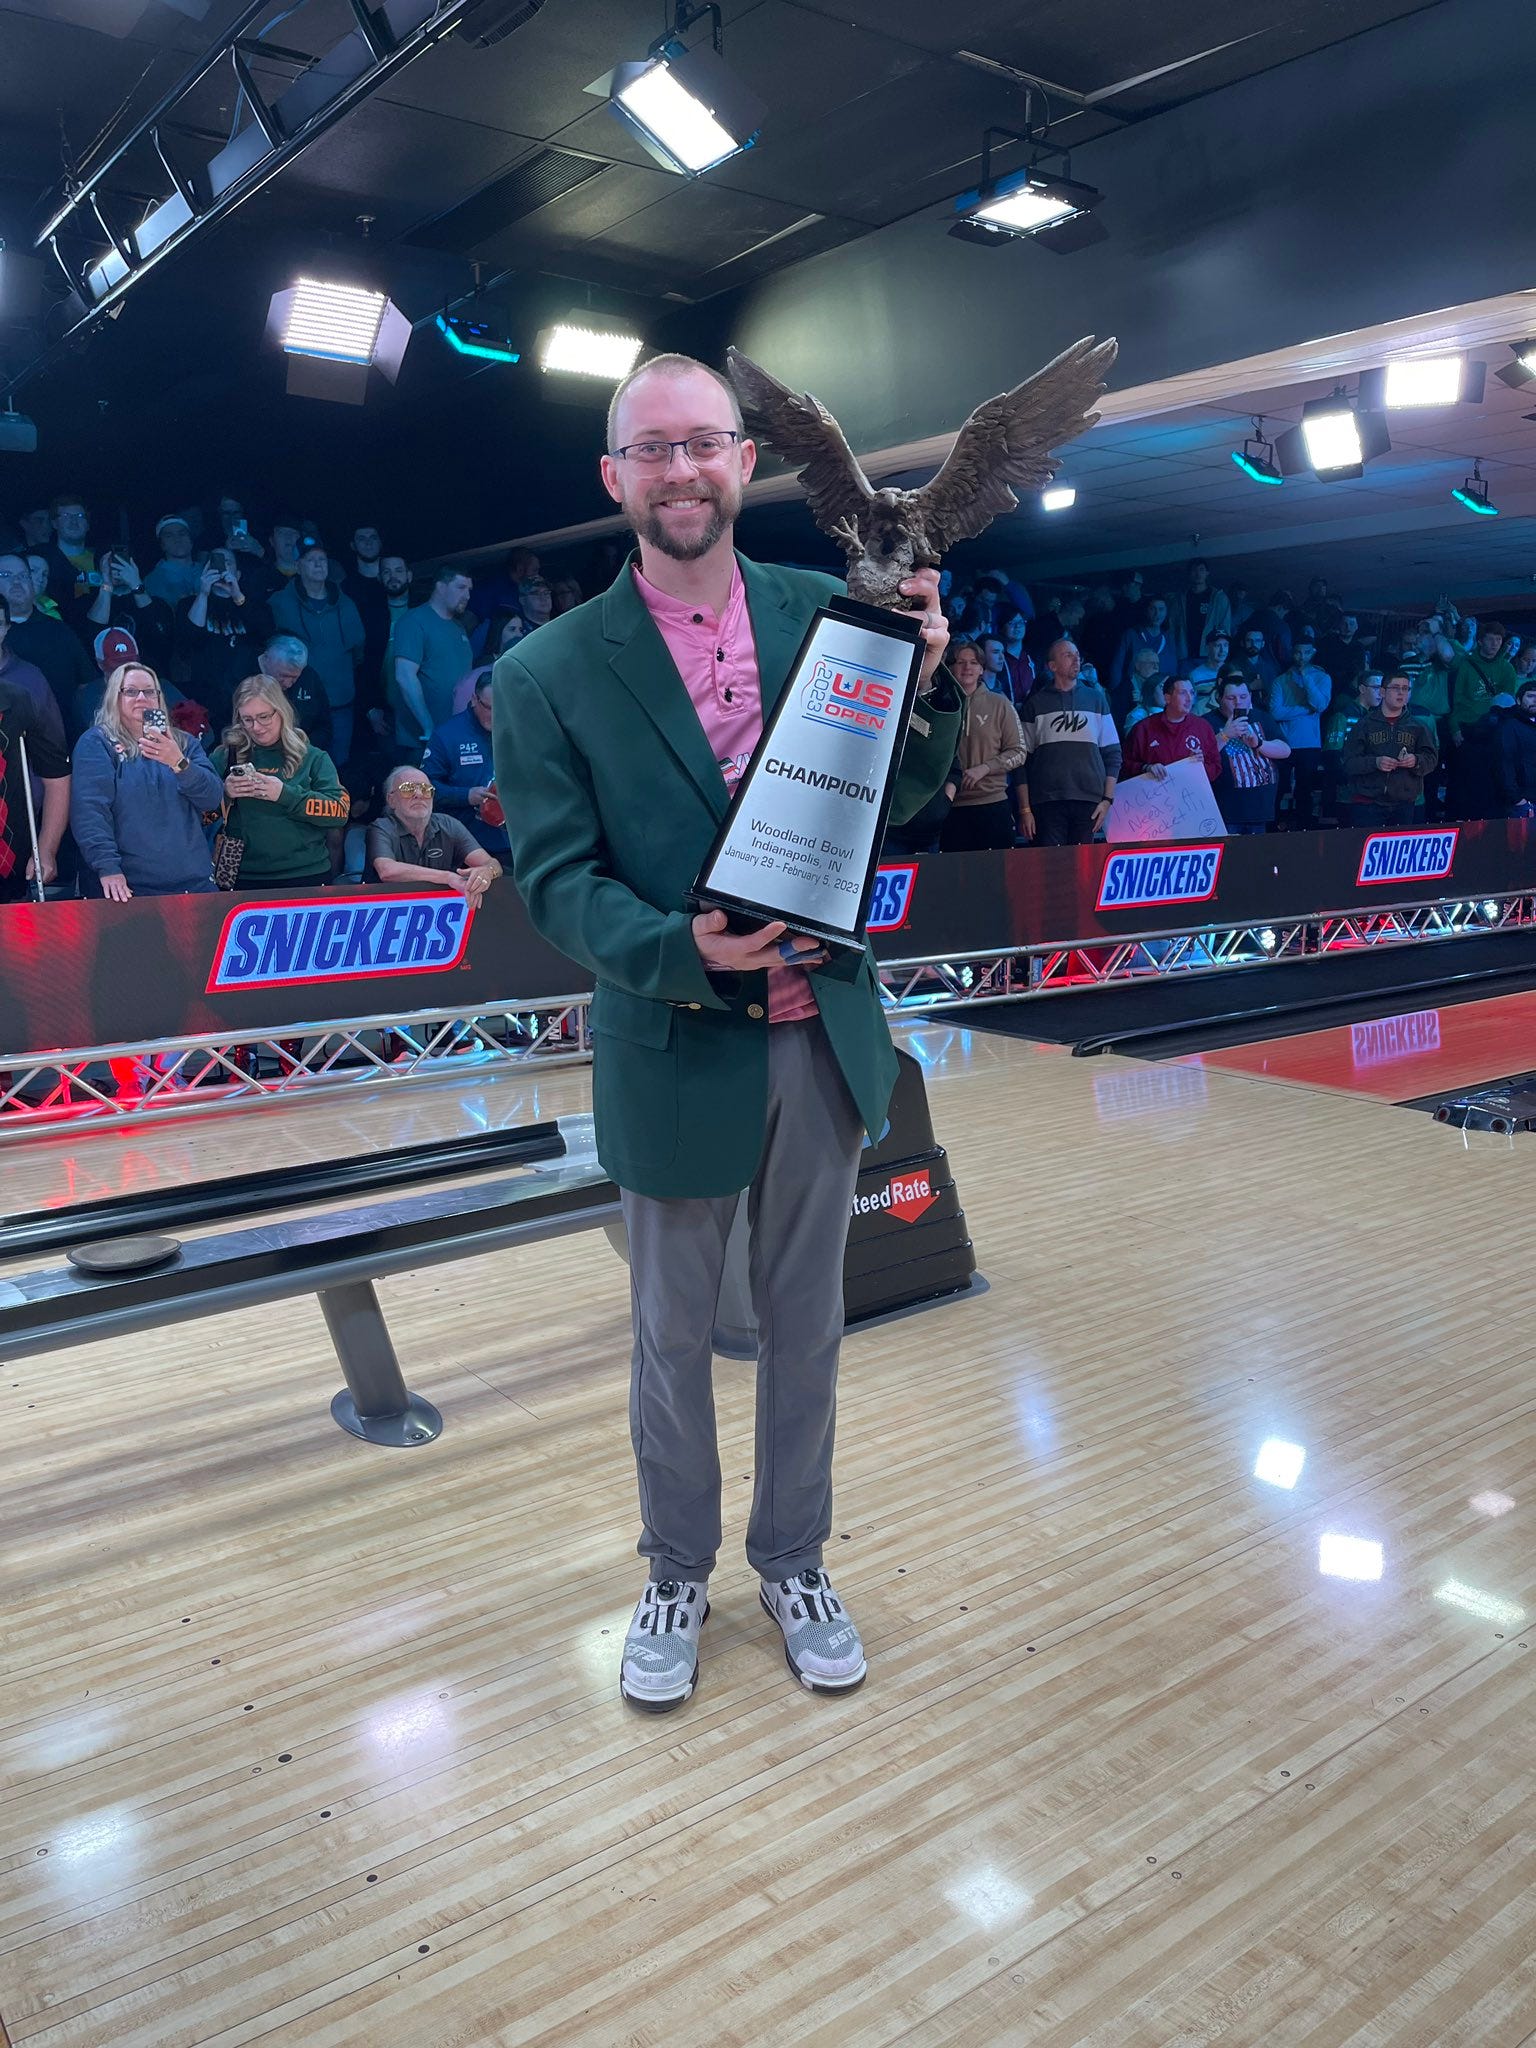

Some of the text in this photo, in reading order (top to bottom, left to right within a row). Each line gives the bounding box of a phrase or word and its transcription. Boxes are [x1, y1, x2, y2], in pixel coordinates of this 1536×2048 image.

[807, 667, 833, 713] 2023
[832, 672, 893, 709] US
[825, 703, 885, 730] OPEN
[765, 758, 877, 804] CHAMPION
[751, 818, 855, 860] Woodland Bowl
[752, 837, 843, 873] Indianapolis, IN
[1364, 836, 1453, 877] SNICKERS
[725, 845, 759, 866] January
[761, 855, 774, 868] 29
[783, 862, 821, 885] February
[834, 878, 860, 894] 2023
[1104, 852, 1216, 901] SNICKERS
[224, 902, 464, 978] SNICKERS
